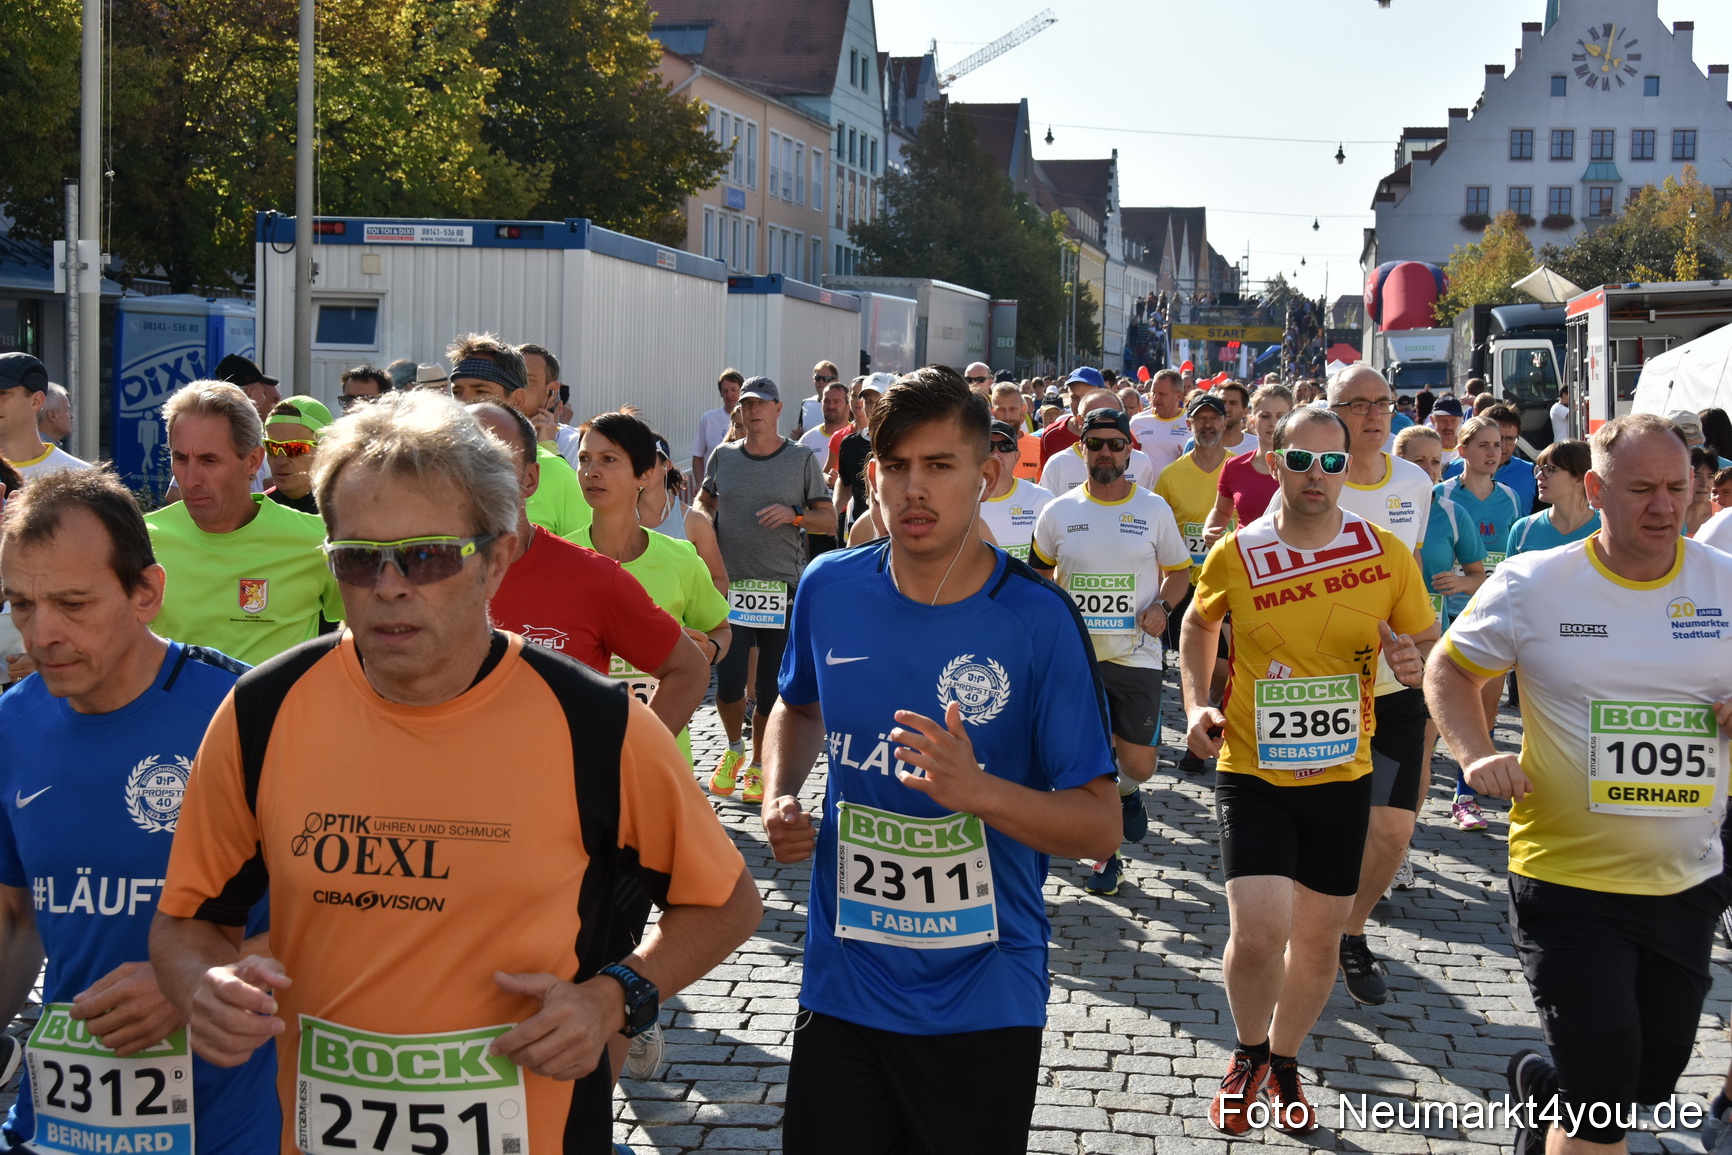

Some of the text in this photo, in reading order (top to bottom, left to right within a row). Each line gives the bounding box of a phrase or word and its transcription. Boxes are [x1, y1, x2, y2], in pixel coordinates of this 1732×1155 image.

[143, 321, 166, 331] 08141
[173, 324, 187, 332] 536
[189, 325, 198, 333] 80
[1208, 329, 1246, 338] START
[1011, 507, 1022, 515] 20
[1387, 498, 1400, 508] 20
[1121, 514, 1134, 523] 20
[734, 579, 782, 591] BOCK
[1074, 576, 1129, 589] BOCK
[1253, 564, 1391, 611] MAX BÖGL
[735, 593, 780, 611] 2025
[1075, 594, 1129, 613] 2026
[1669, 602, 1696, 618] 20
[738, 614, 775, 622] JÜRGEN
[1671, 619, 1729, 629] Neumarkter
[1560, 623, 1607, 634] BOCK
[1673, 630, 1721, 640] Stadtlauf
[964, 693, 978, 702] 40
[1264, 682, 1350, 702] BOCK
[1268, 709, 1350, 738] 2386
[1600, 705, 1709, 732] BOCK
[1269, 743, 1349, 758] SEBASTIAN
[1607, 741, 1705, 777] 1095
[156, 798, 172, 807] 40
[1607, 786, 1700, 803] GERHARD
[374, 820, 416, 833] UHREN
[420, 824, 445, 835] UND
[450, 825, 511, 839] SCHMUCK
[850, 811, 972, 851] BOCK
[314, 833, 450, 879] OEXL
[977, 860, 983, 868] C
[853, 854, 969, 903] 2311
[313, 890, 445, 912] CIBA VISION
[871, 910, 957, 934] FABIAN
[314, 1030, 492, 1082] BOCK
[174, 1070, 182, 1080] D
[43, 1061, 168, 1116] 2312
[319, 1093, 491, 1155] 2751
[47, 1122, 174, 1153] BERNHARD
